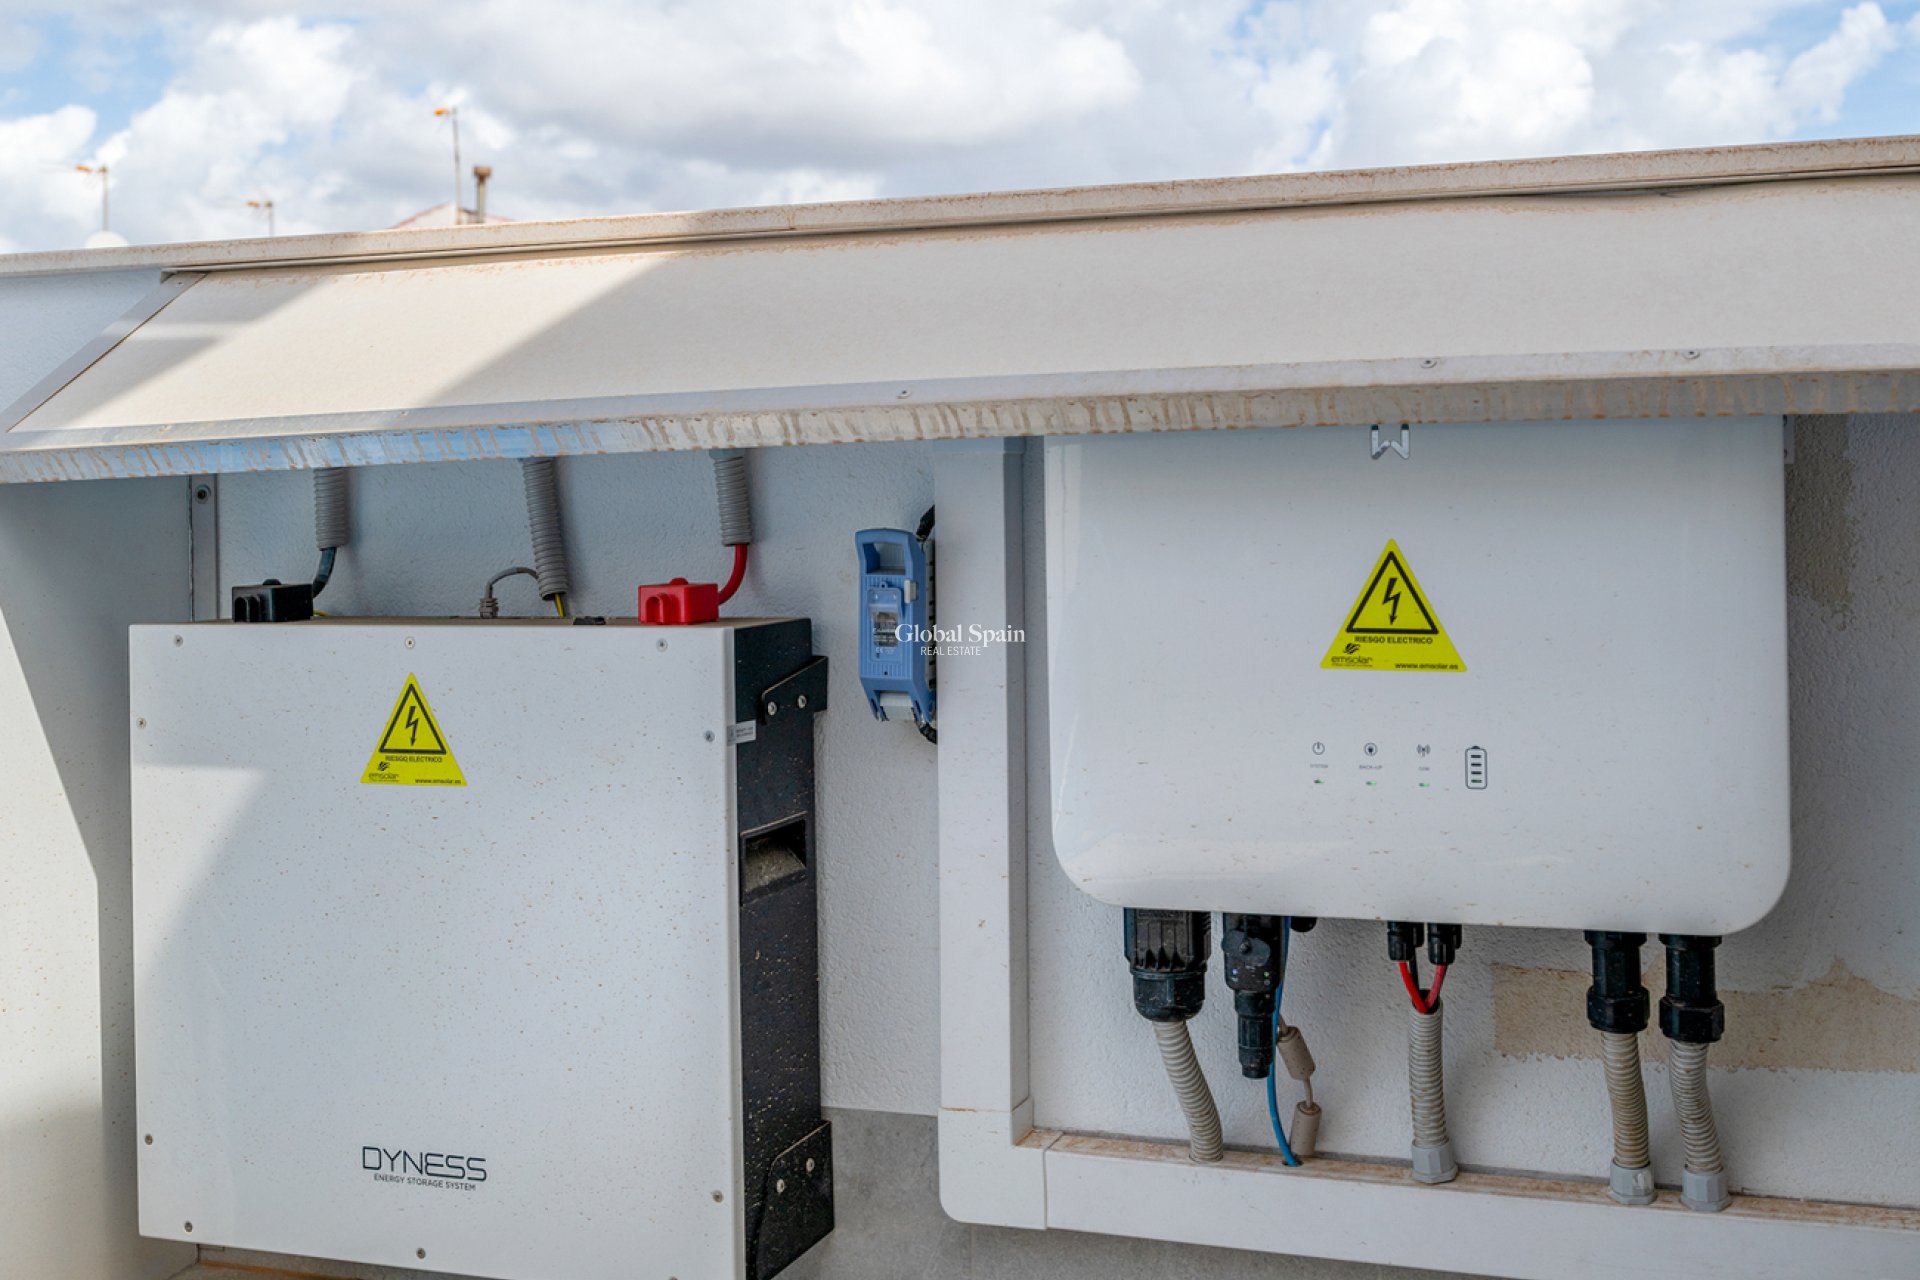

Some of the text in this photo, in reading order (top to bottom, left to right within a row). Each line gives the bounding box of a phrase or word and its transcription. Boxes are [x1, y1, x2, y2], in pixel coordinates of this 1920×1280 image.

[1354, 636, 1433, 645] RIESGO ELECTRICO
[1331, 656, 1373, 664] emsolar
[362, 1146, 487, 1182] DYNESS
[374, 1172, 476, 1192] ENERGY STORAGE SYSTEM
